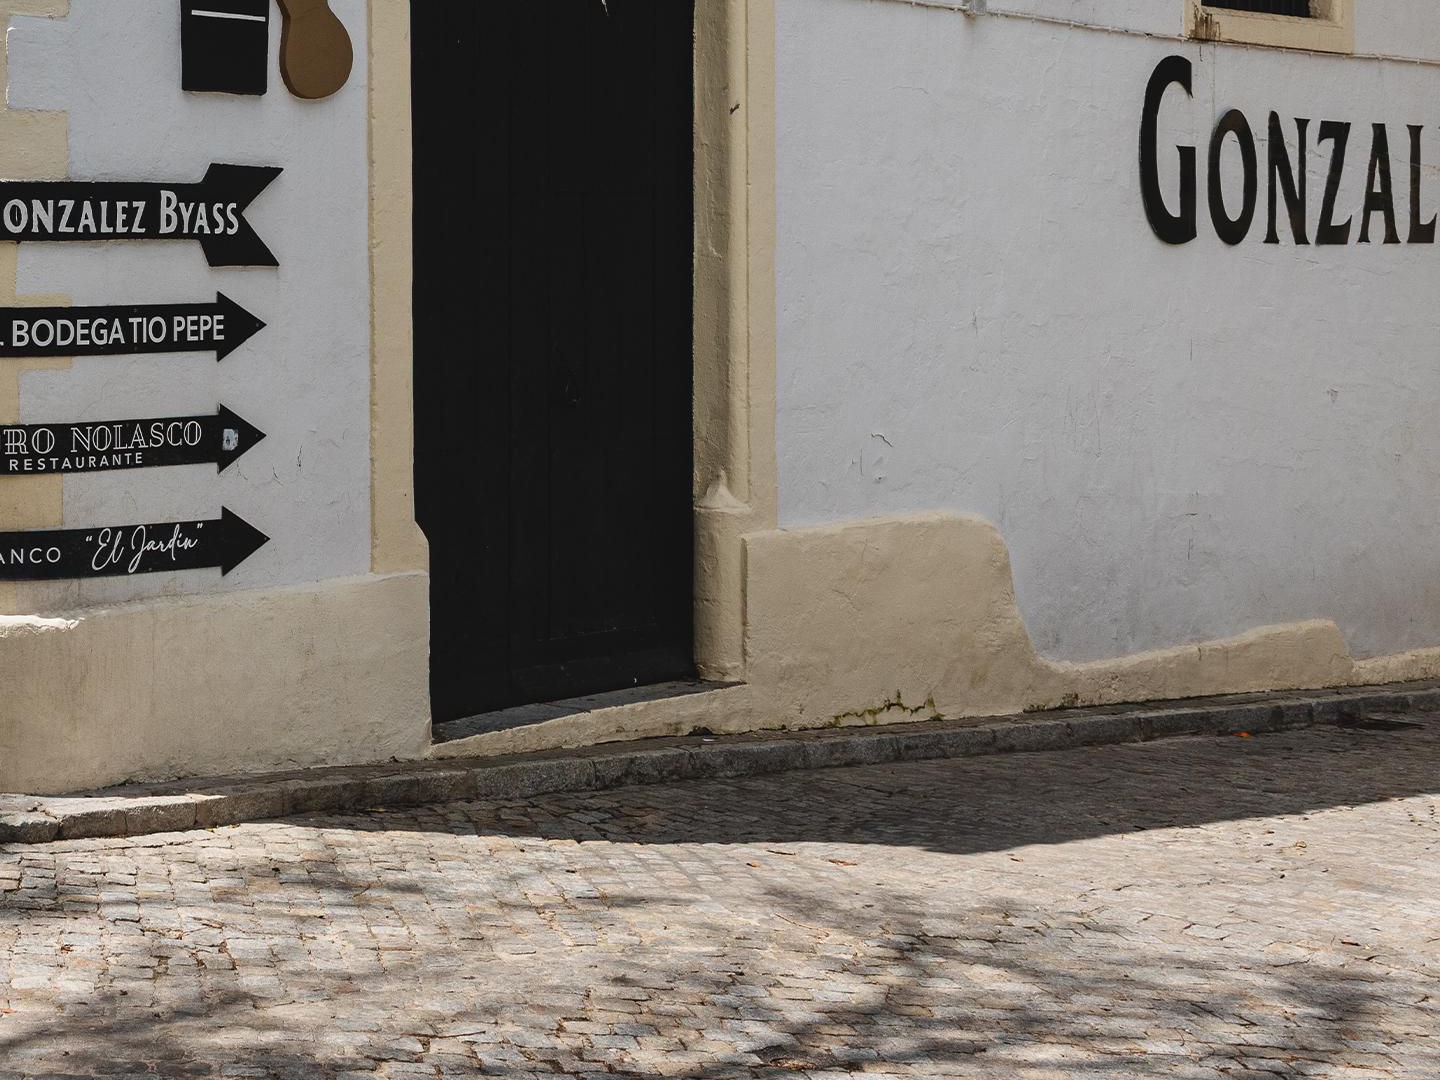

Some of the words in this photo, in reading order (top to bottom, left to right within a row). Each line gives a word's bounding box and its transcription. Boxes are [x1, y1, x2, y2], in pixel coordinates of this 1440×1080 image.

[1139, 55, 1440, 246] GONZAL
[159, 189, 240, 235] BYASS
[12, 318, 125, 347] BODEGA
[128, 316, 167, 344] TIO
[173, 314, 225, 342] PEPE
[70, 420, 202, 453] NOLASCO
[9, 452, 144, 471] RESTAURANTE
